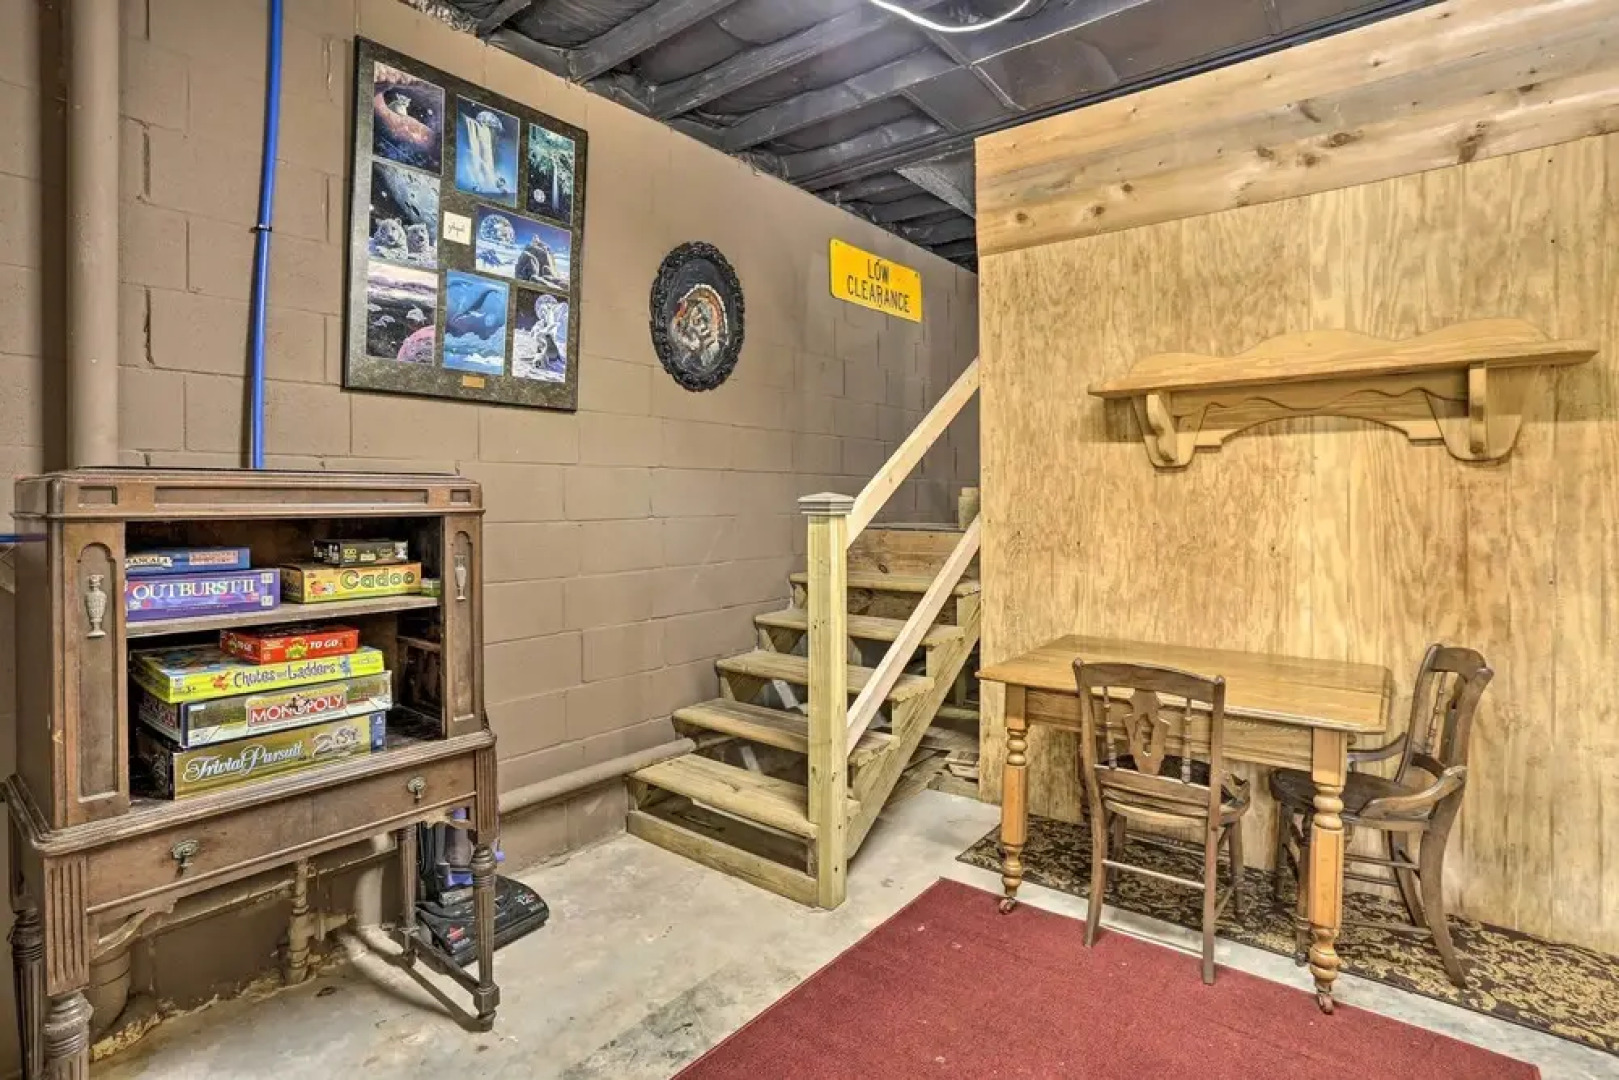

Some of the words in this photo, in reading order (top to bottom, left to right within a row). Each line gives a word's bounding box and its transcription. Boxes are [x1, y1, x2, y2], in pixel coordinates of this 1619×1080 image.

[867, 259, 889, 283] LOW
[847, 274, 910, 313] CLEARANCE
[132, 580, 241, 600] OUTBURST
[340, 568, 415, 590] Cadoo
[234, 669, 276, 689] Chutes
[287, 662, 336, 681] Ladders
[251, 695, 343, 723] MONOPOLY
[182, 749, 248, 783] Trivial
[240, 741, 304, 776] Pursuit
